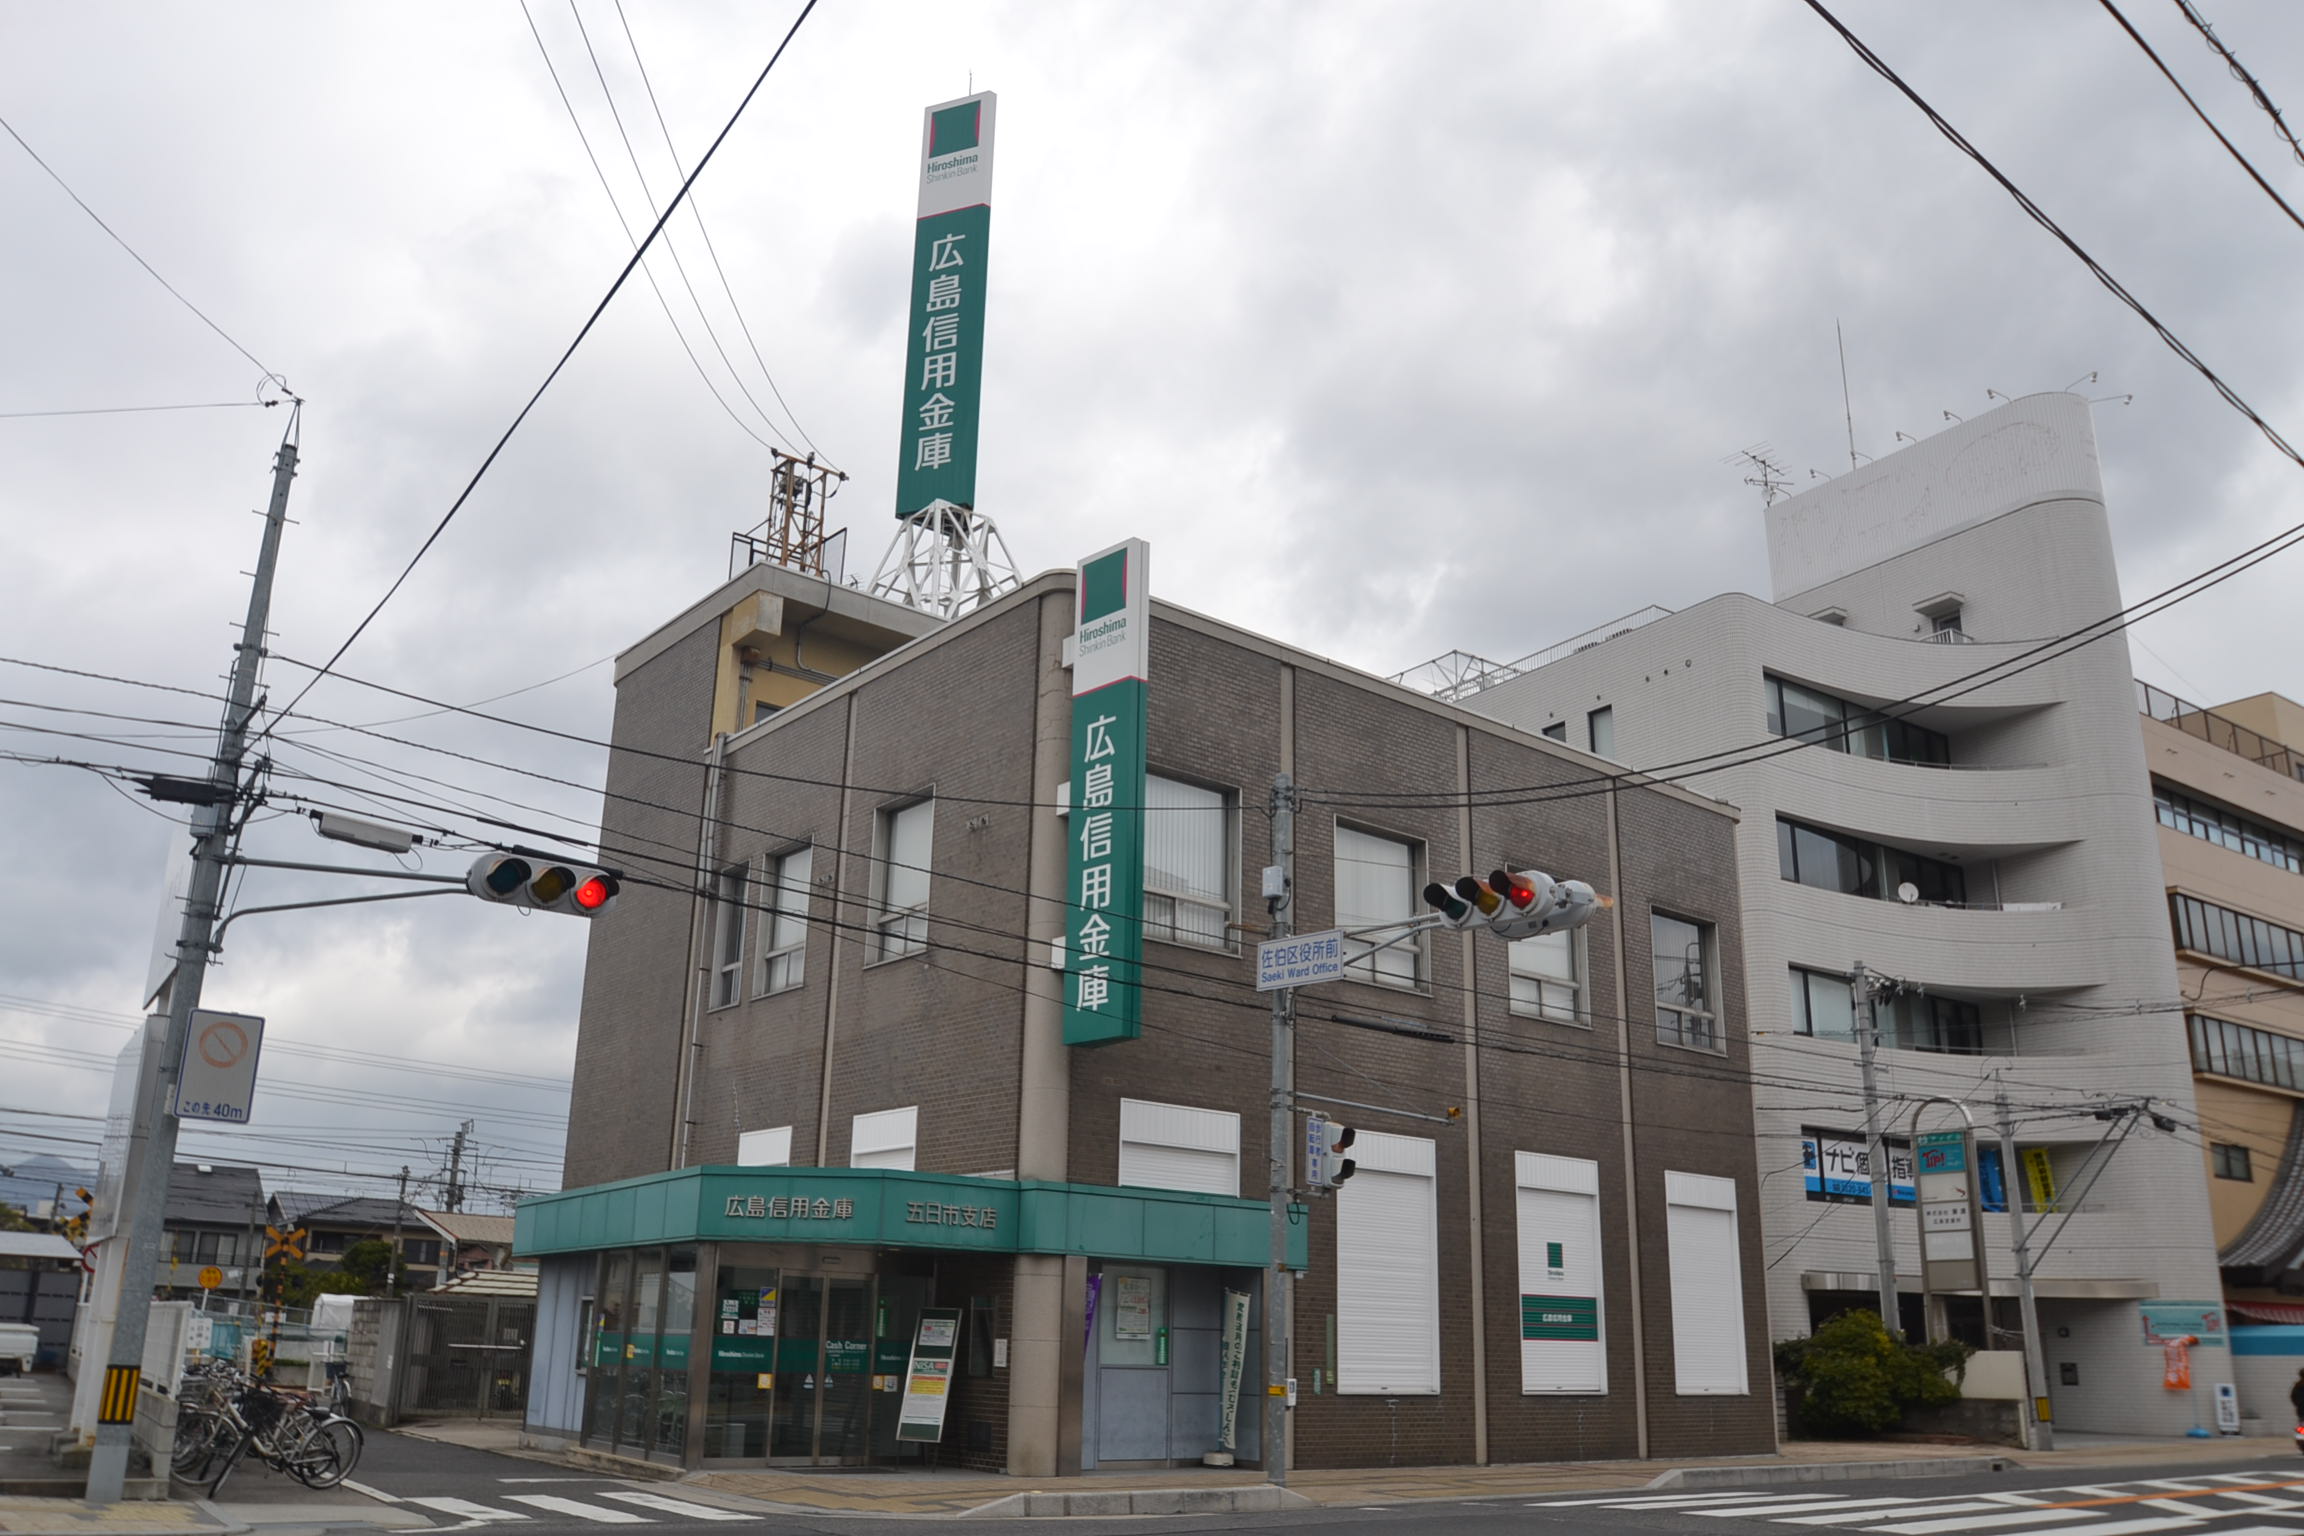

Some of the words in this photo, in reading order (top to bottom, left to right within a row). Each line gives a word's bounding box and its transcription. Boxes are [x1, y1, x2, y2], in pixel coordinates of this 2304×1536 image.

[927, 154, 979, 174] Hiroshima
[957, 164, 977, 177] Bank
[914, 232, 966, 472] 広島信用金庫
[1079, 617, 1127, 645] Hiroshima
[1107, 630, 1127, 647] Bank
[1076, 714, 1117, 1013] 広島信用金庫
[1262, 937, 1339, 969] 佐伯区役所前
[1261, 970, 1285, 983] Saeki
[1287, 966, 1310, 978] Ward
[1312, 962, 1338, 975] Office
[184, 1101, 210, 1115] この先
[214, 1103, 242, 1119] 40m
[724, 1194, 854, 1220] 広島信用金庫
[906, 1200, 998, 1229] 五日市支店
[825, 1341, 843, 1350] Cash
